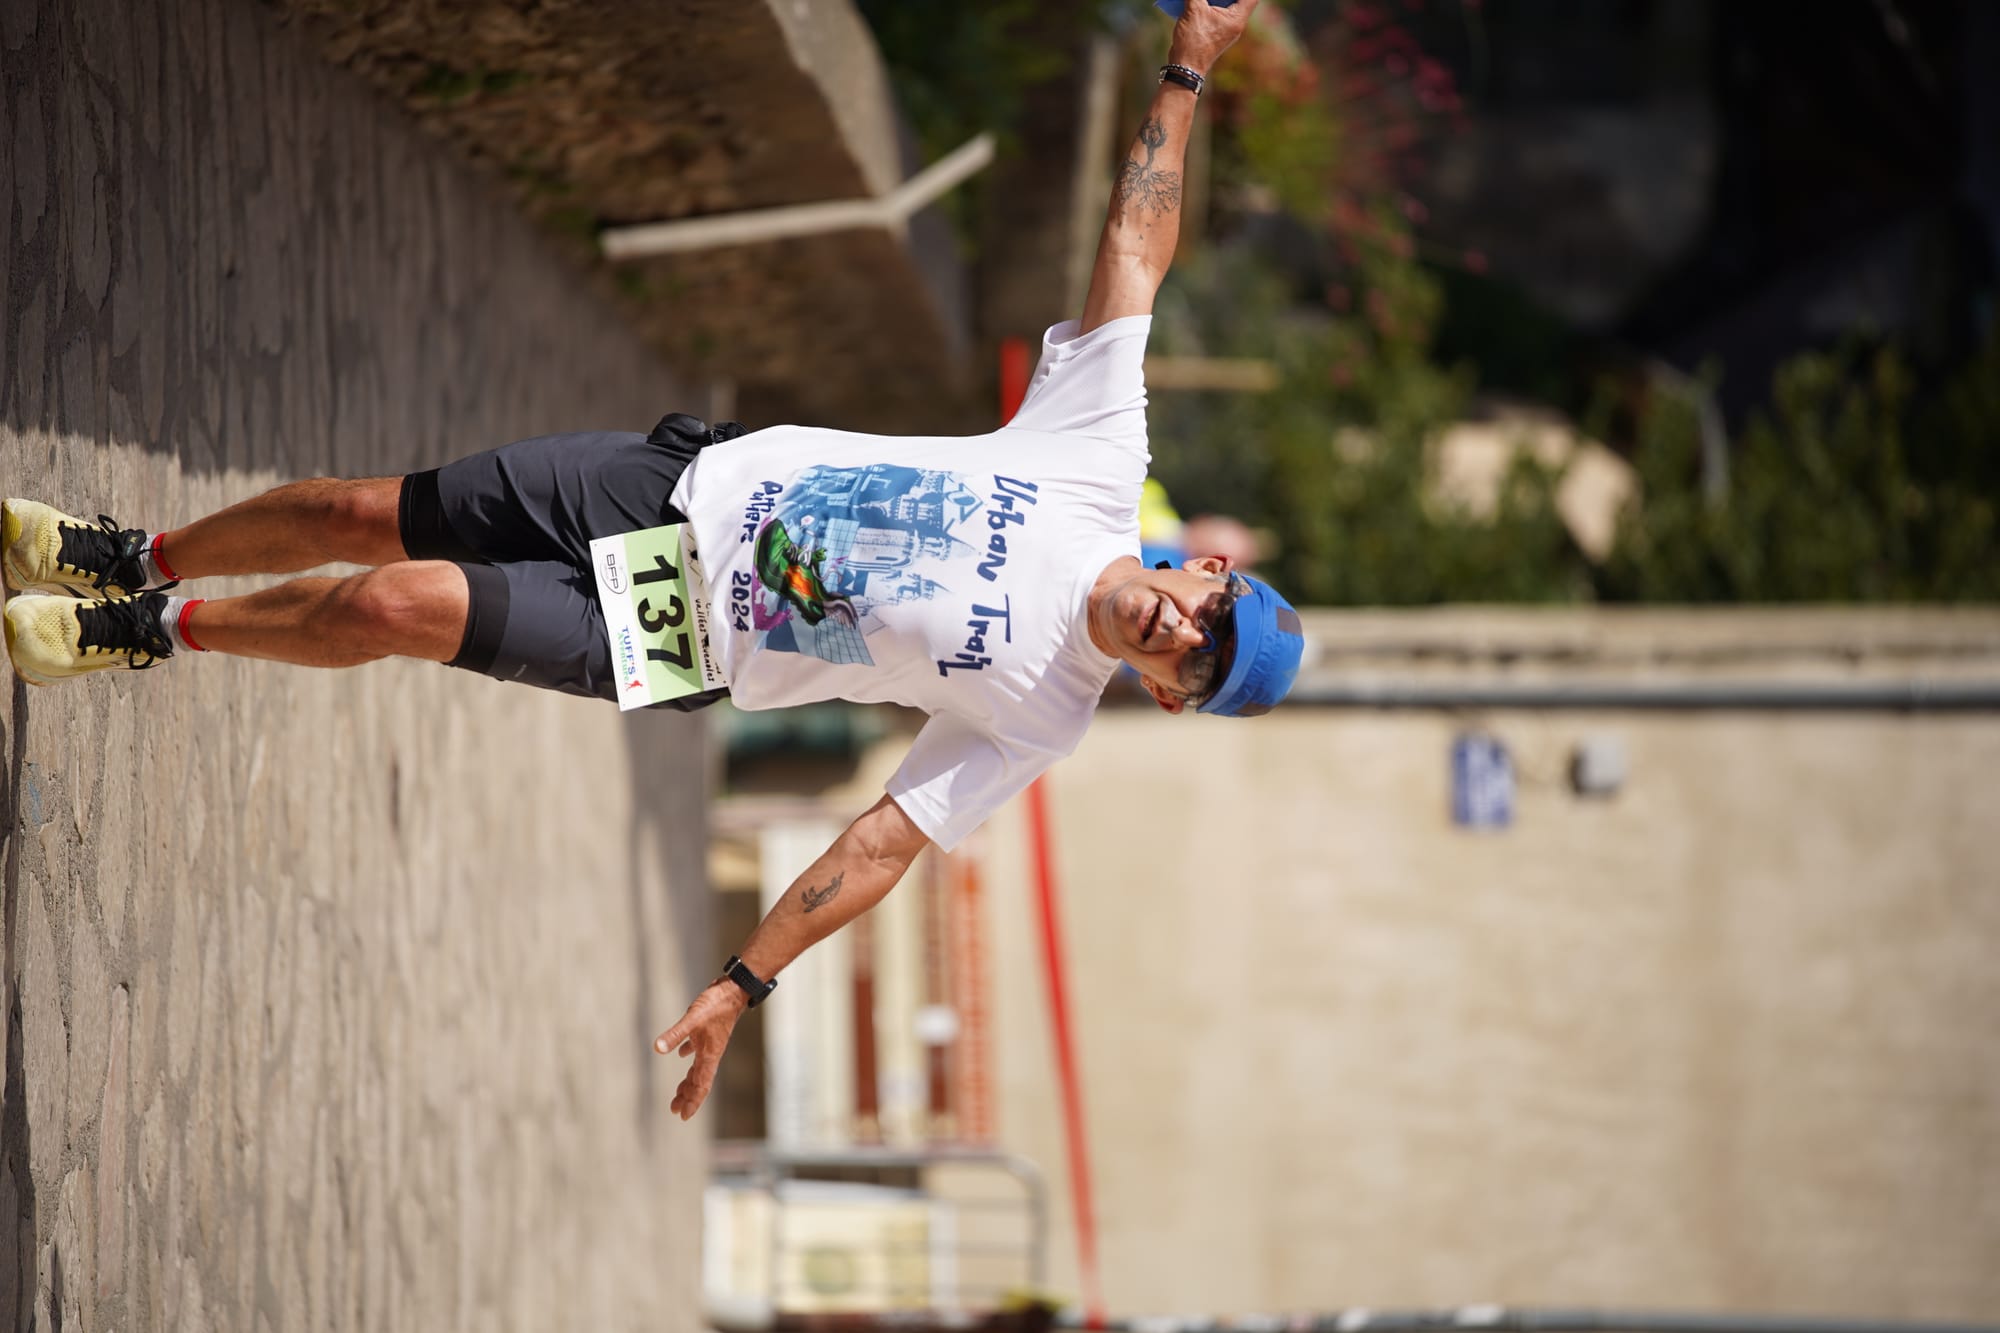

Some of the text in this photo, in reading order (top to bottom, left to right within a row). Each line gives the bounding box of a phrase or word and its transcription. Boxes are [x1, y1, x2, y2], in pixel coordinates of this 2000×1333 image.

[606, 553, 619, 589] BFP
[632, 554, 694, 670] 137
[731, 570, 752, 632] 2024
[622, 625, 636, 675] TUFF'S
